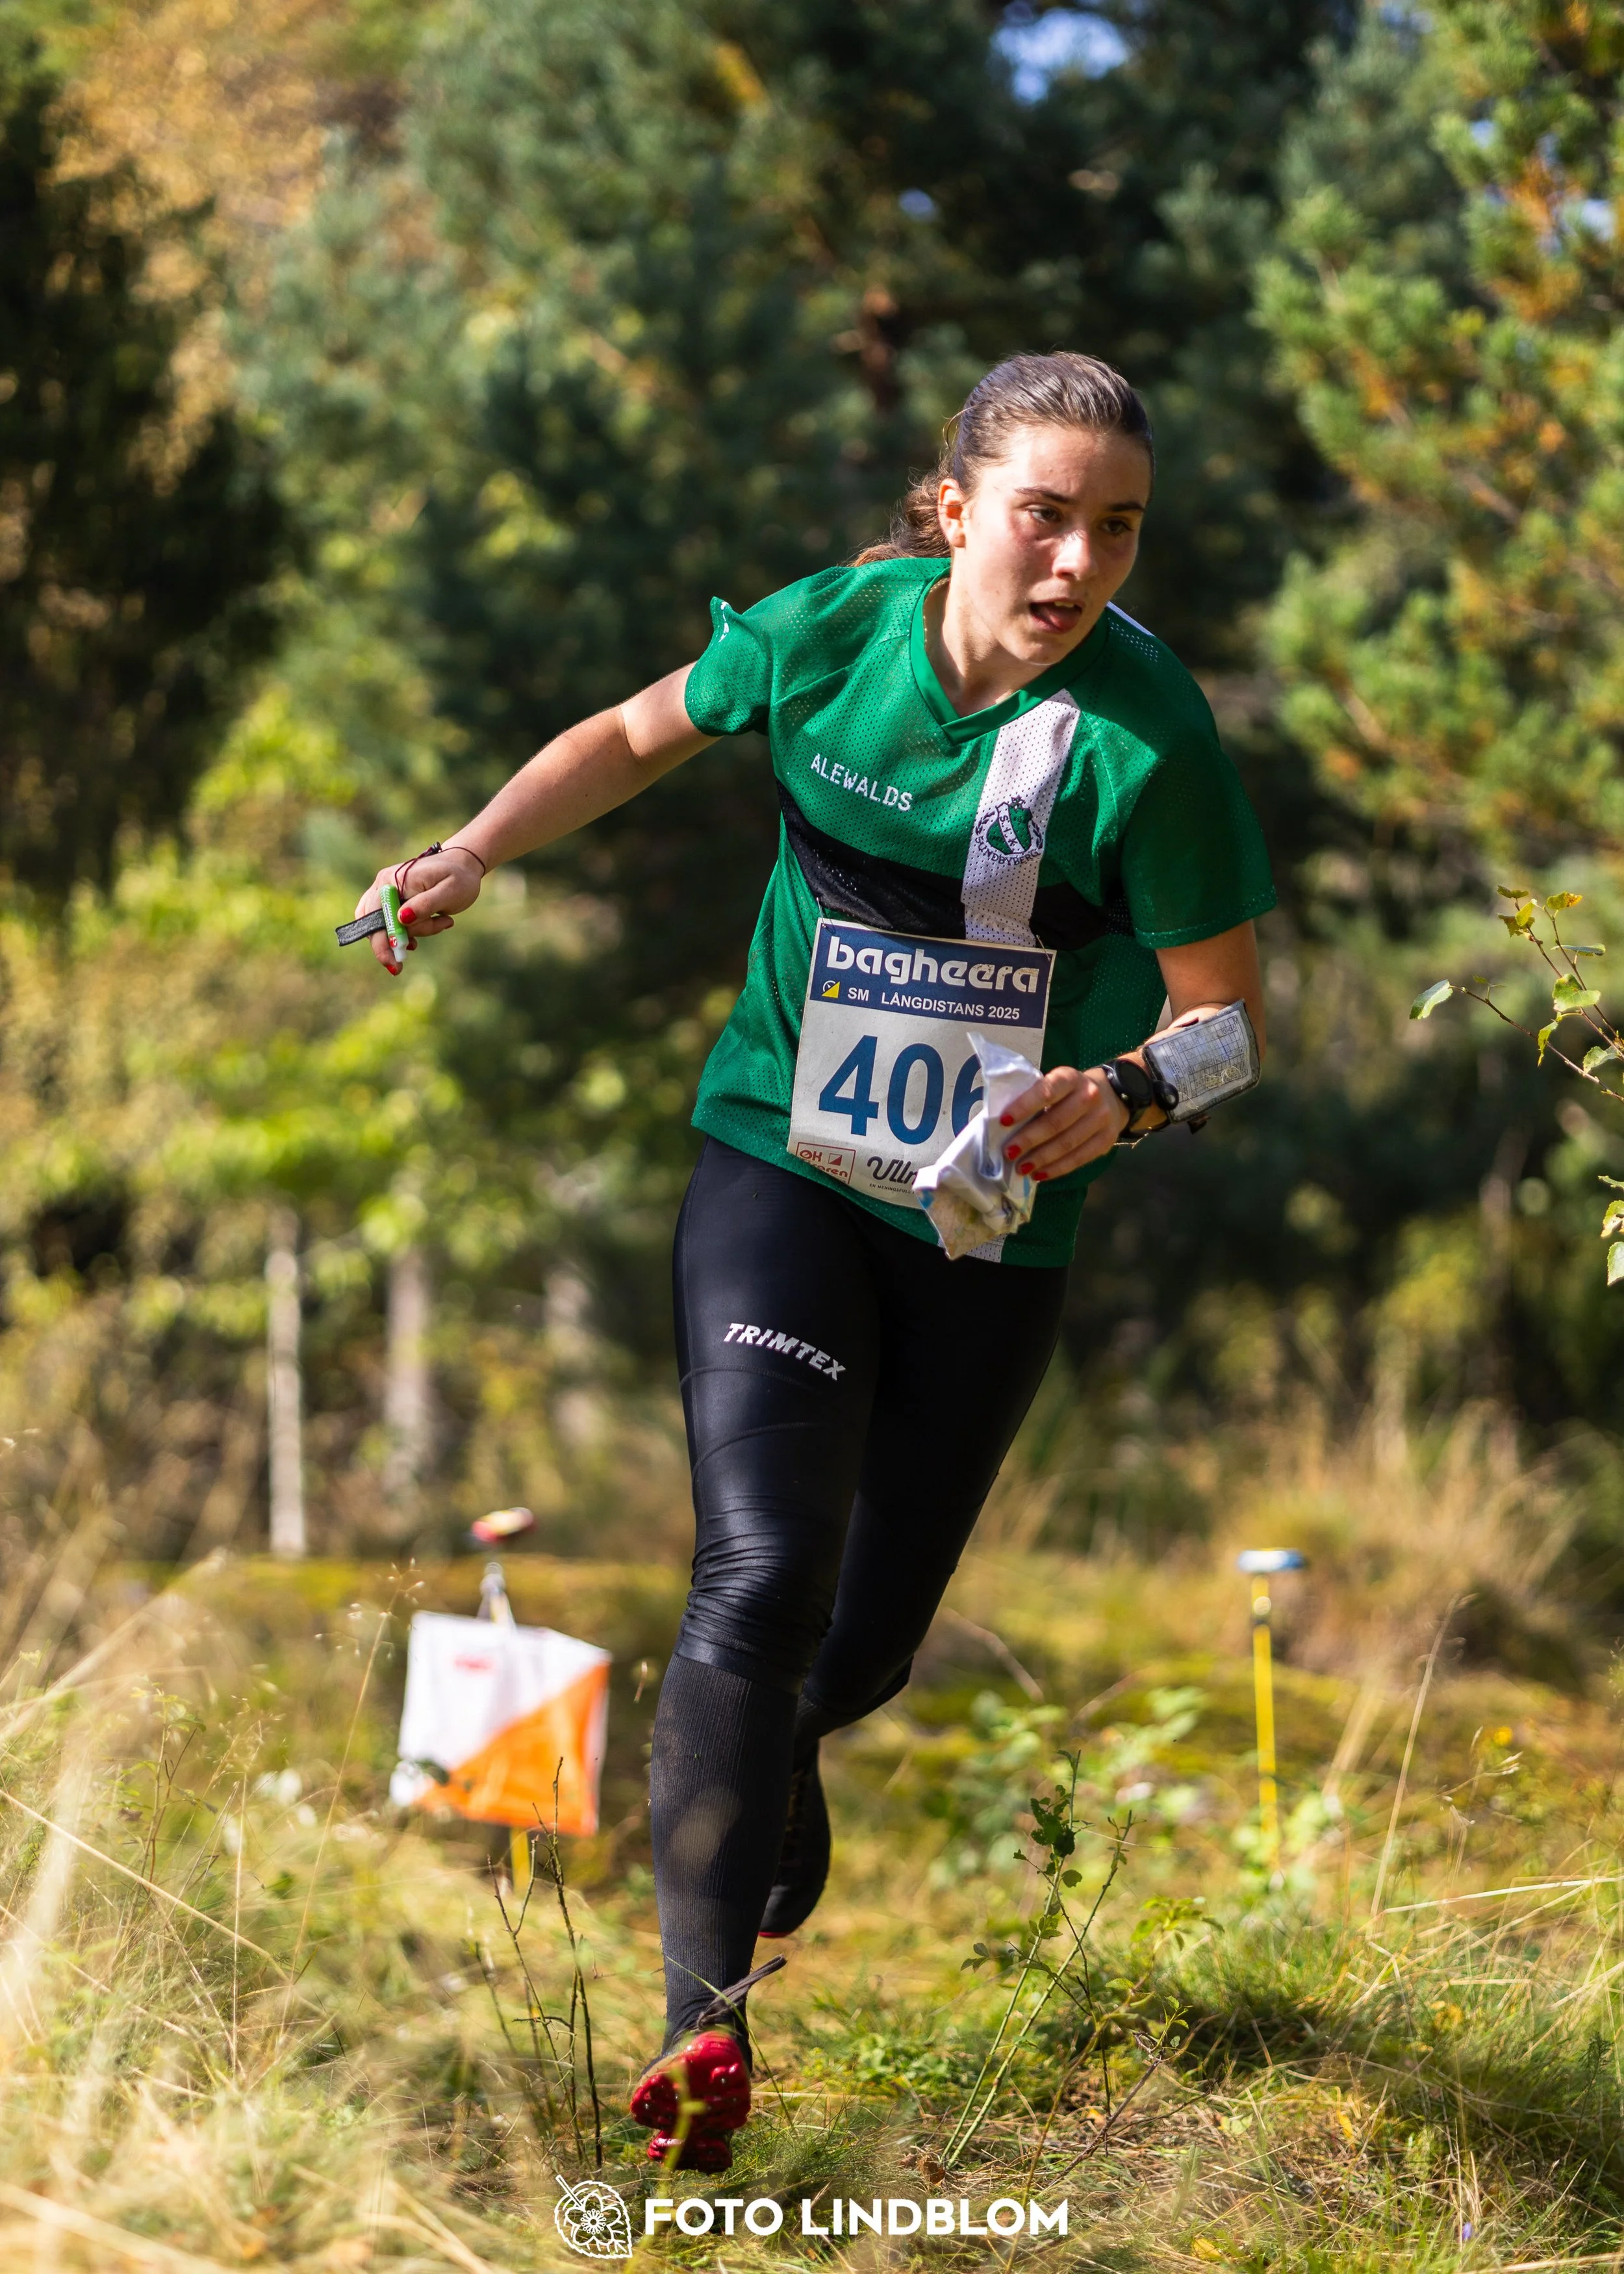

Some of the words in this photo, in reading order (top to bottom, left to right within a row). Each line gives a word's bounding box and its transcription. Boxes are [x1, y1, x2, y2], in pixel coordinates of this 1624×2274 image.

[810, 753, 913, 812] ALEWALDS
[974, 836, 1041, 866] SUNDBYBERG
[826, 936, 1040, 993] bagheera
[847, 987, 870, 1002] SM
[881, 991, 985, 1017] LÅNGDISTANS
[987, 1004, 1021, 1021] 2025
[723, 1322, 846, 1381] TRIMTEX
